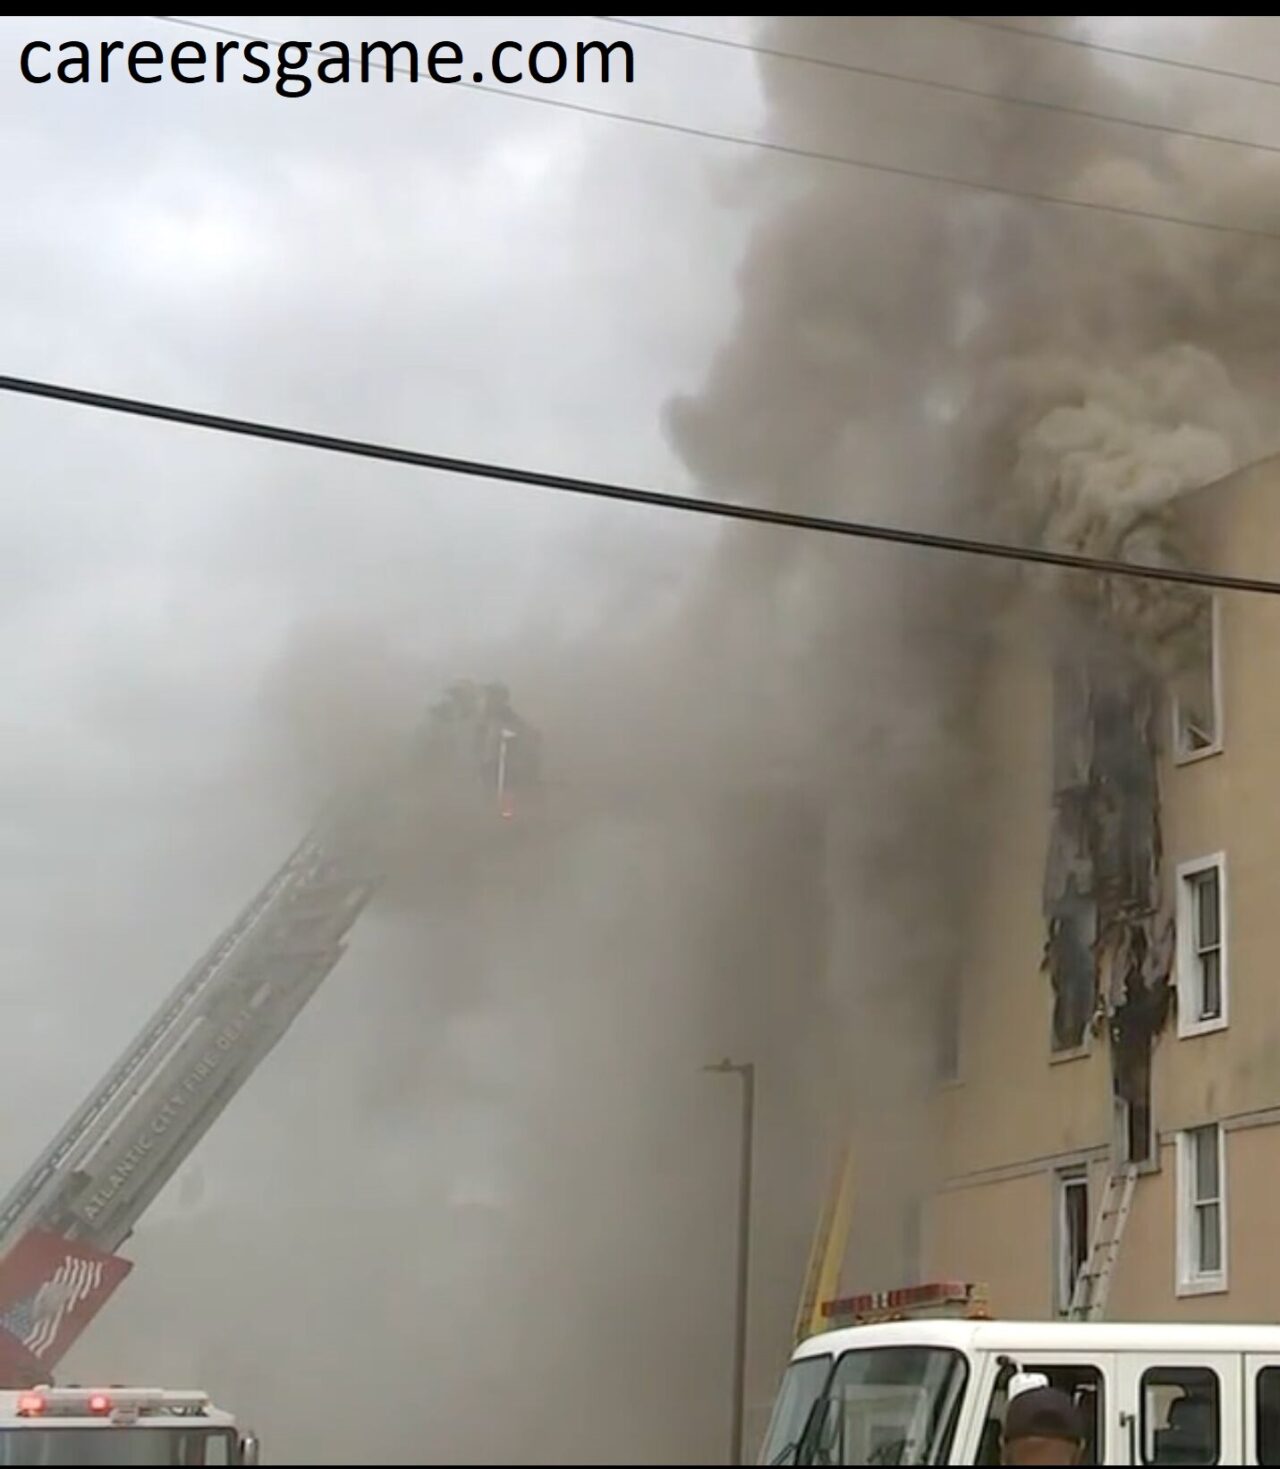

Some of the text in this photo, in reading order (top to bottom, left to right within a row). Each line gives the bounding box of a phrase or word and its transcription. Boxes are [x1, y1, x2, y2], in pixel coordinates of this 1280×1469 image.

[84, 1137, 152, 1220] ATLANTIC
[152, 1097, 187, 1134] CITY
[183, 1053, 218, 1091] FIRE
